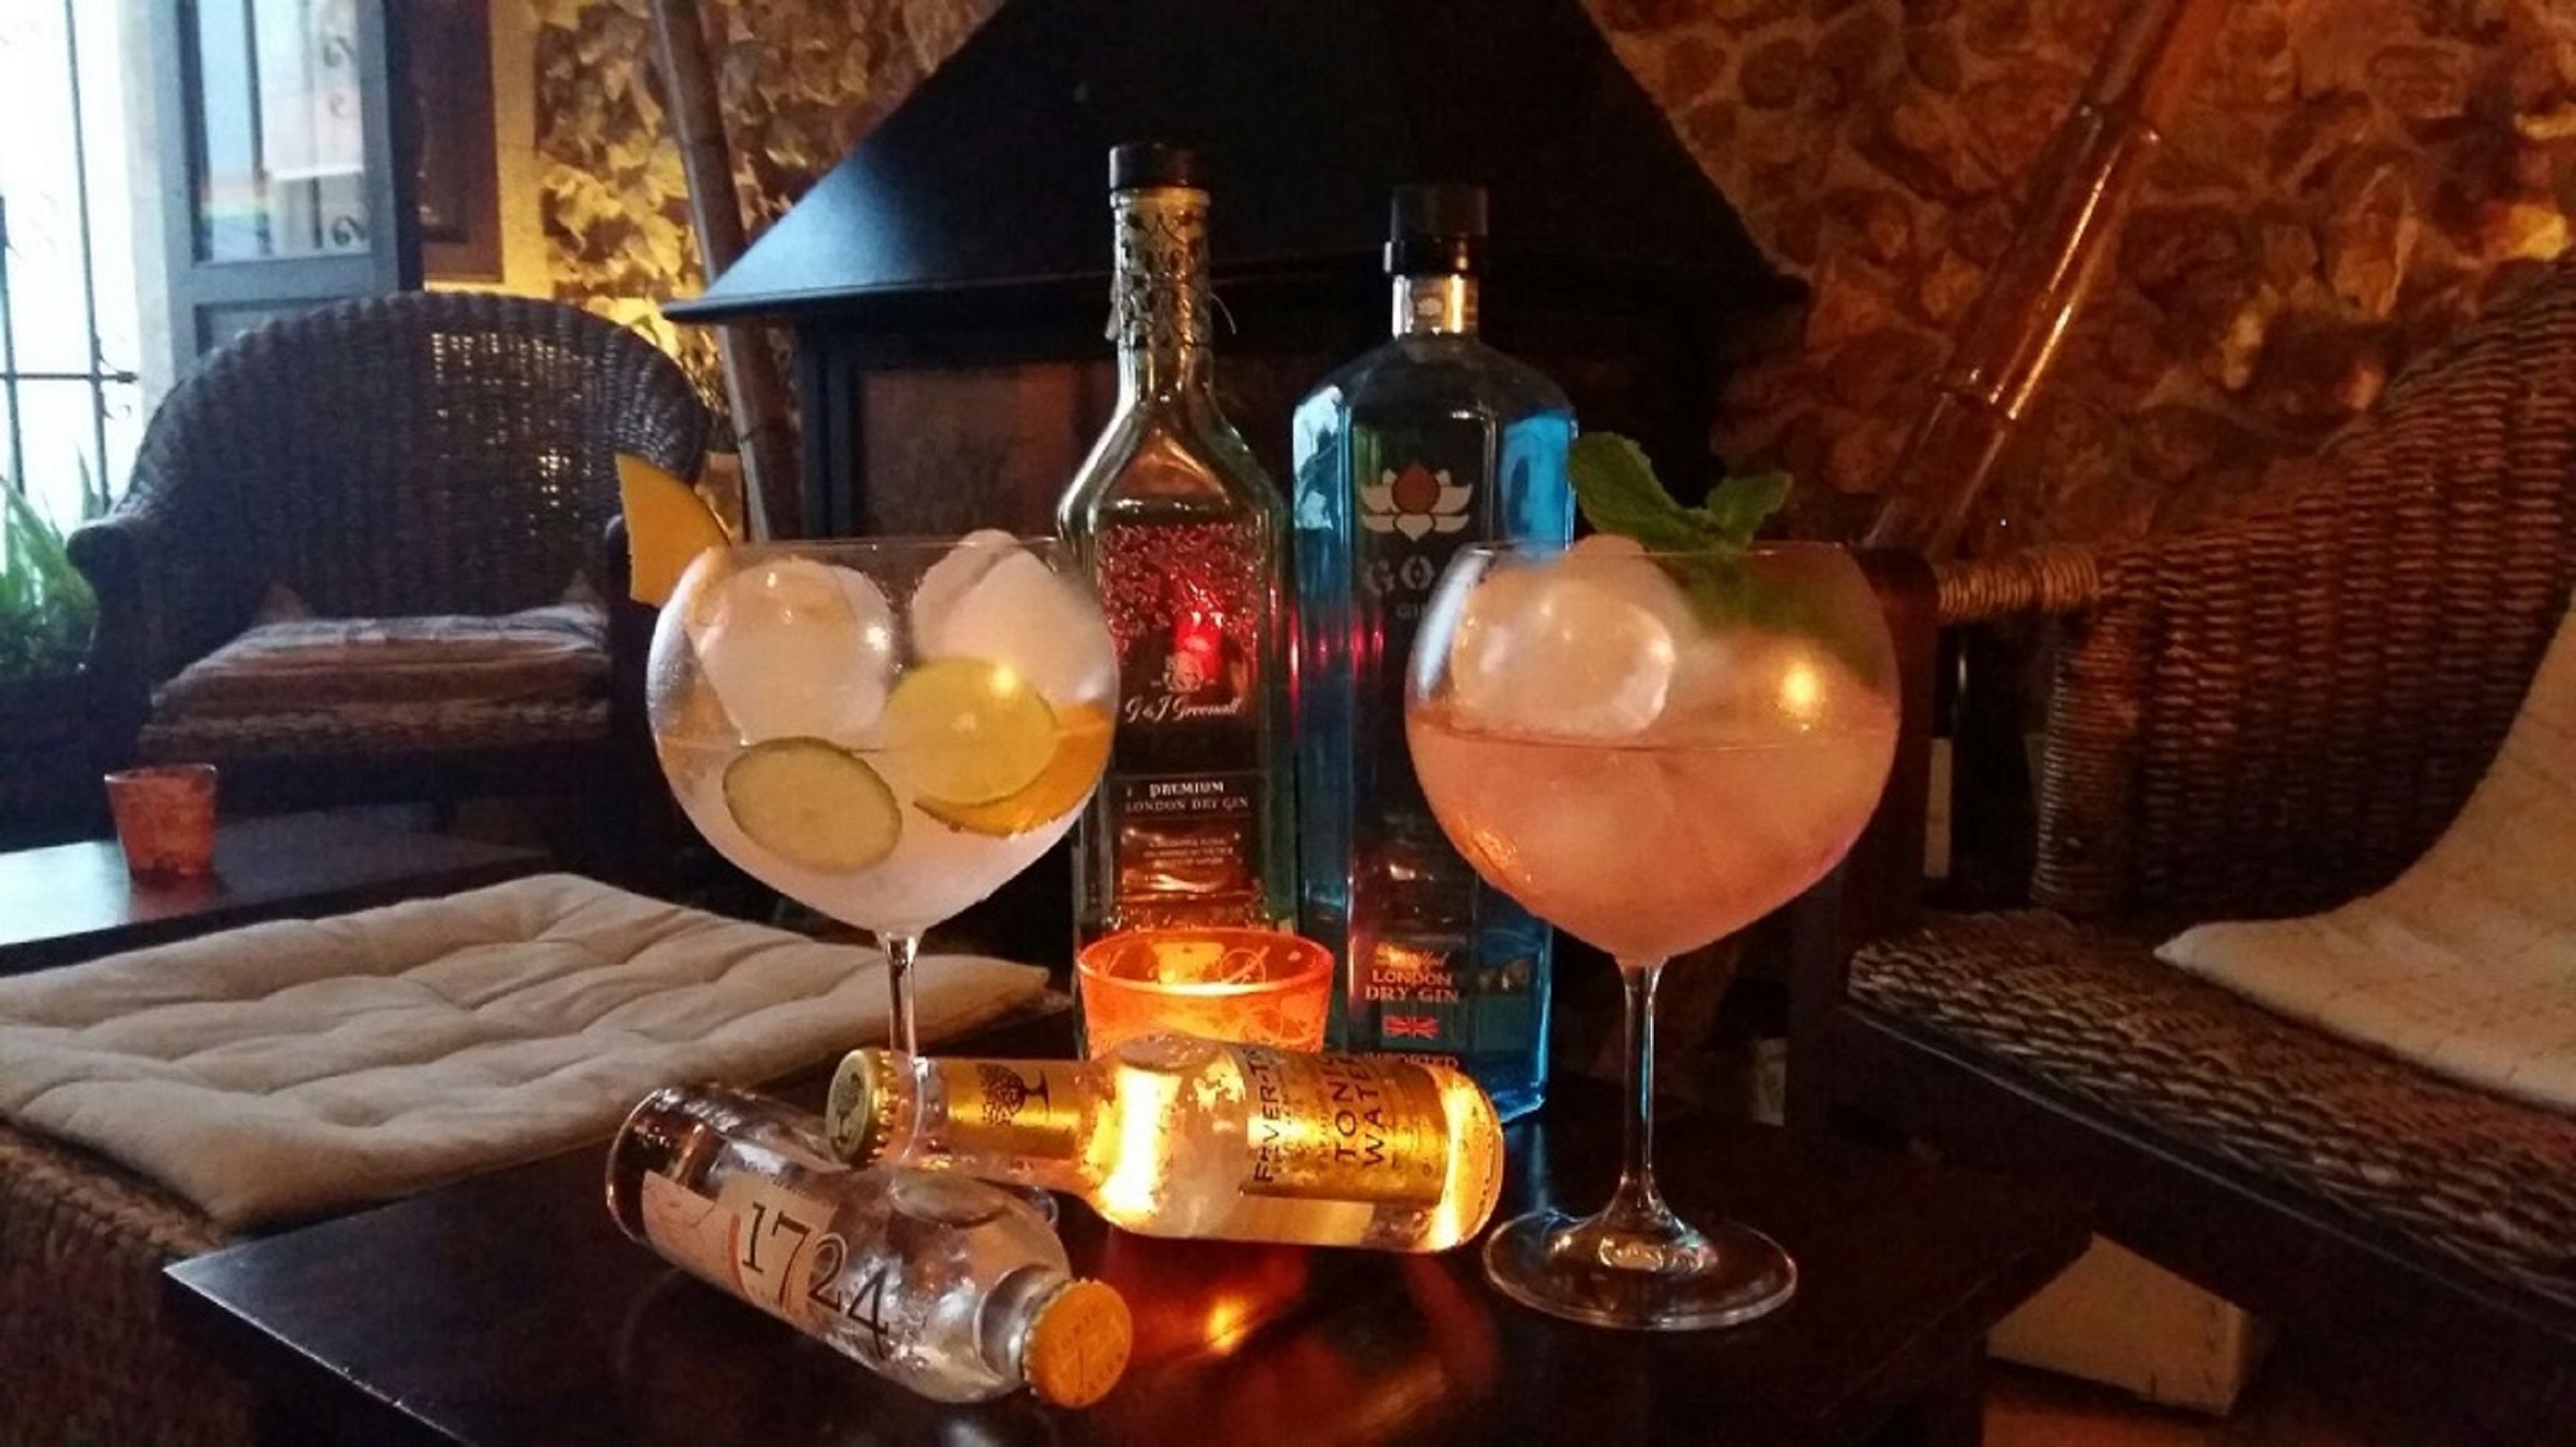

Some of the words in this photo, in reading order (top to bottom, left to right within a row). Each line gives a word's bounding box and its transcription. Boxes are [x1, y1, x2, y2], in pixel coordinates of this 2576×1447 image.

[1363, 554, 1436, 596] GO
[1153, 695, 1173, 723] J
[1148, 781, 1224, 799] PREMIUM
[1124, 800, 1186, 813] LONDON
[1191, 797, 1218, 810] DRY
[1222, 796, 1249, 811] GIN
[1371, 969, 1453, 986] LONDON
[1364, 986, 1410, 1002] DRY
[1418, 987, 1460, 1004] GIN
[741, 1201, 890, 1360] 1724
